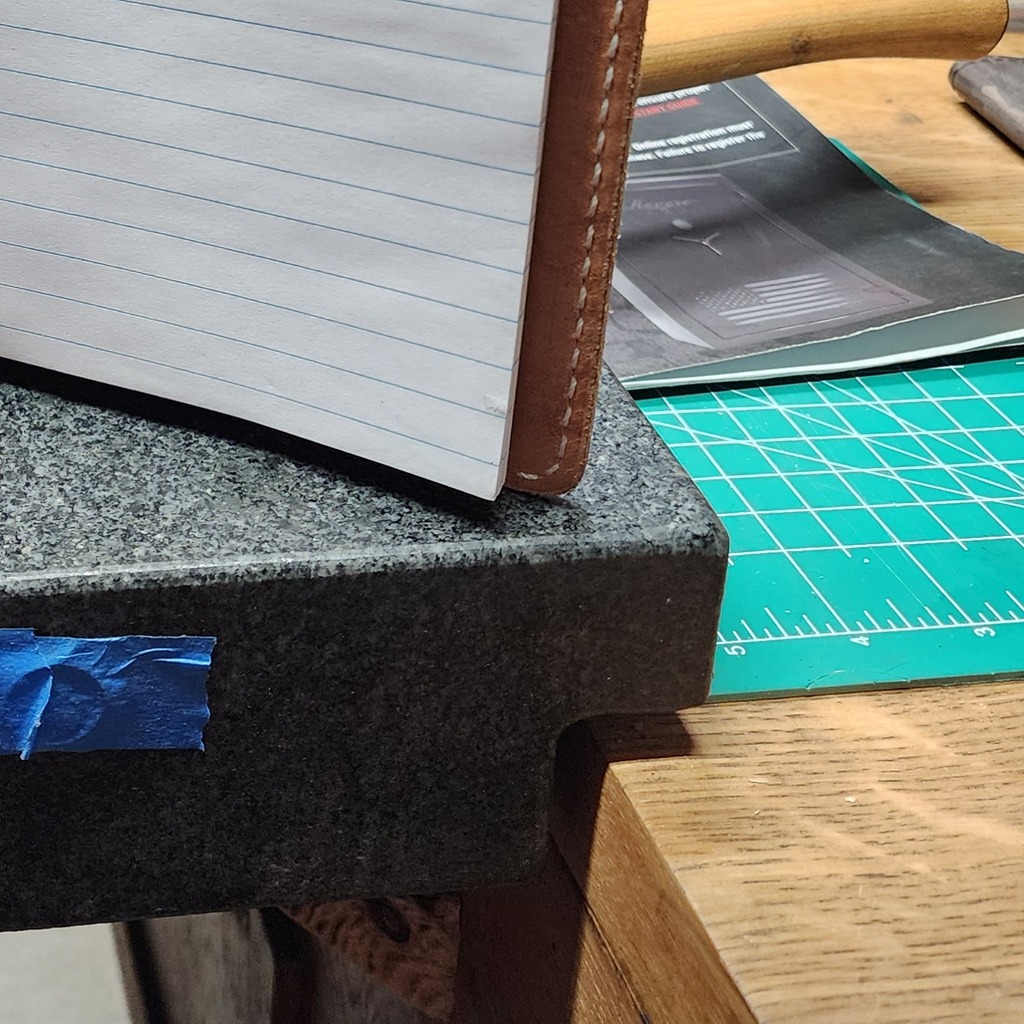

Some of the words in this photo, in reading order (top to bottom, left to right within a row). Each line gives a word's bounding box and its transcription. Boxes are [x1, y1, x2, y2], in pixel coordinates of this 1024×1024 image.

[631, 139, 666, 151] Online
[666, 127, 728, 146] registration
[726, 120, 754, 134] must
[654, 144, 694, 158] Failure
[692, 143, 707, 153] to
[705, 133, 746, 149] register
[745, 130, 766, 141] the
[724, 645, 746, 657] 5
[849, 634, 870, 647] 4
[974, 625, 997, 638] 3
